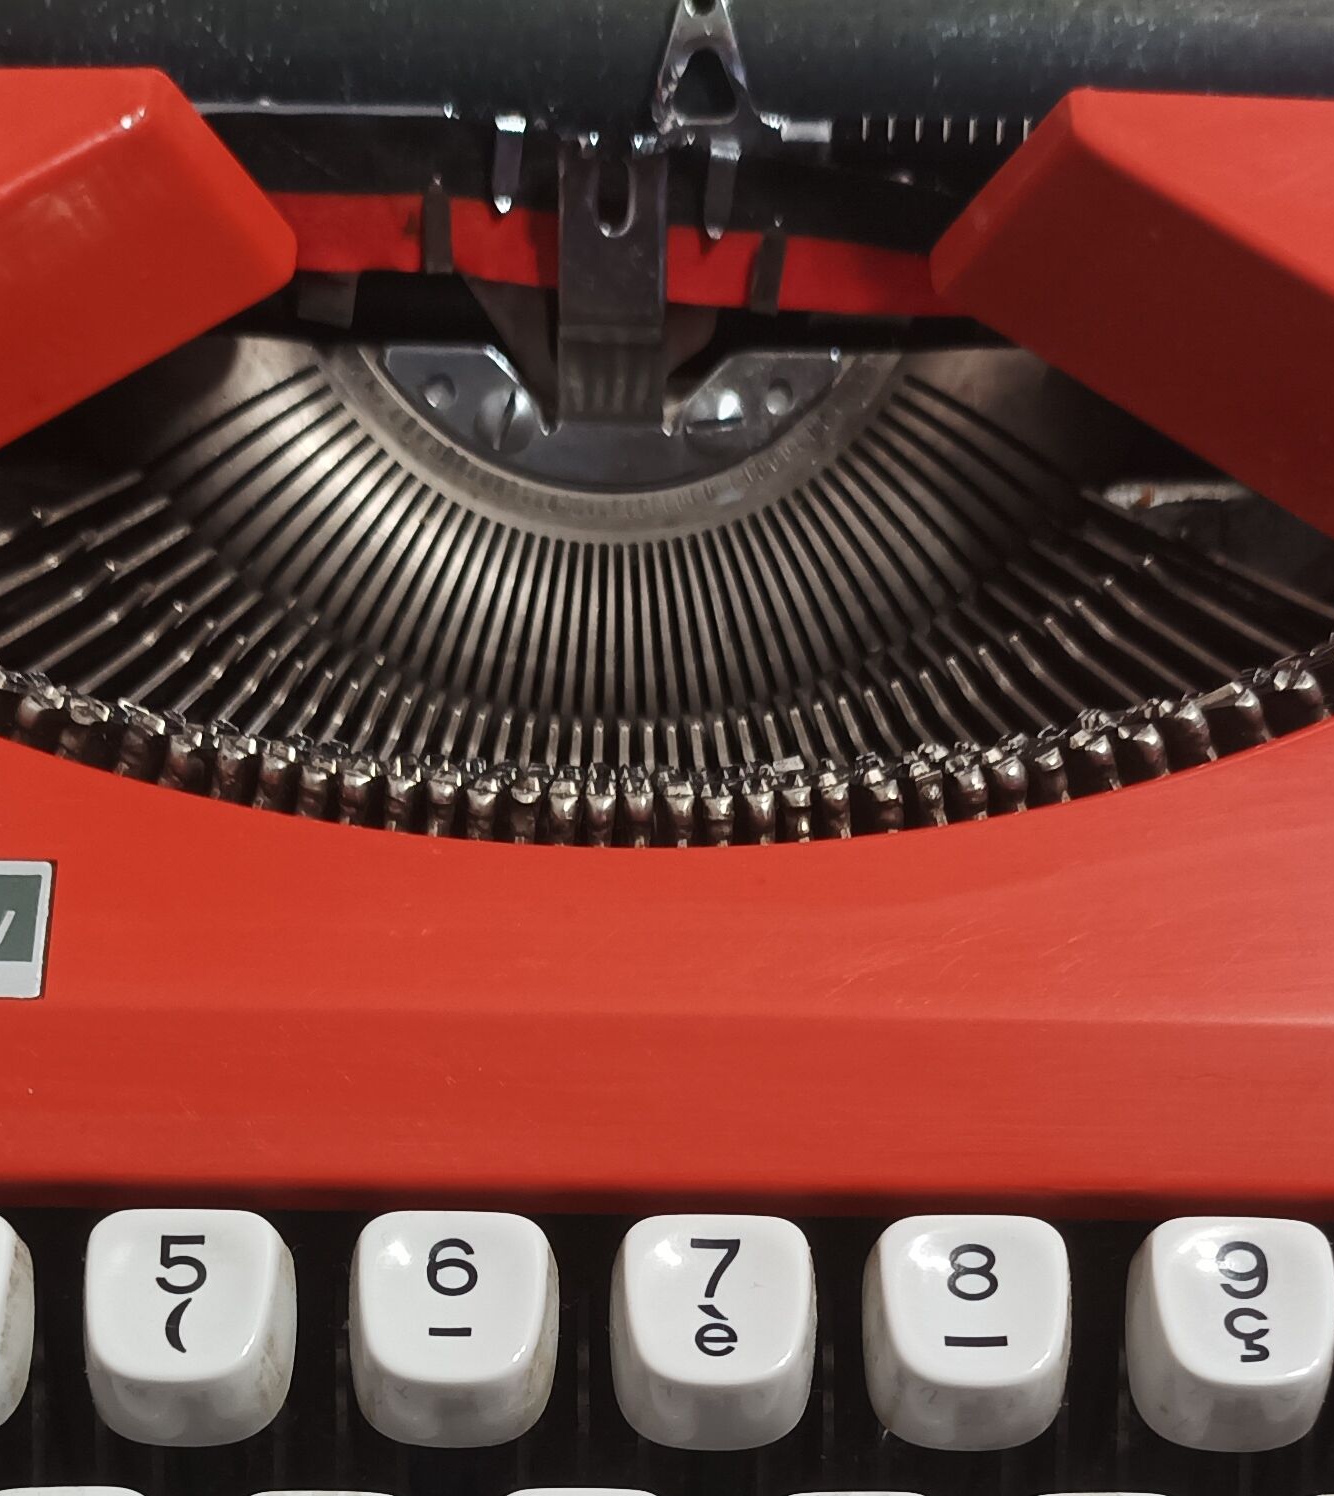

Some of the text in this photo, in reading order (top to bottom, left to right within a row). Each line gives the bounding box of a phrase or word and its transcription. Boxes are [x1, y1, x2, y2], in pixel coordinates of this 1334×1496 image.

[156, 1235, 206, 1294] 5
[427, 1238, 478, 1296] 6
[691, 1239, 740, 1298] 7
[948, 1244, 998, 1301] 8
[1215, 1241, 1269, 1299] 9
[695, 1305, 737, 1356] è
[1224, 1308, 1269, 1362] ç
